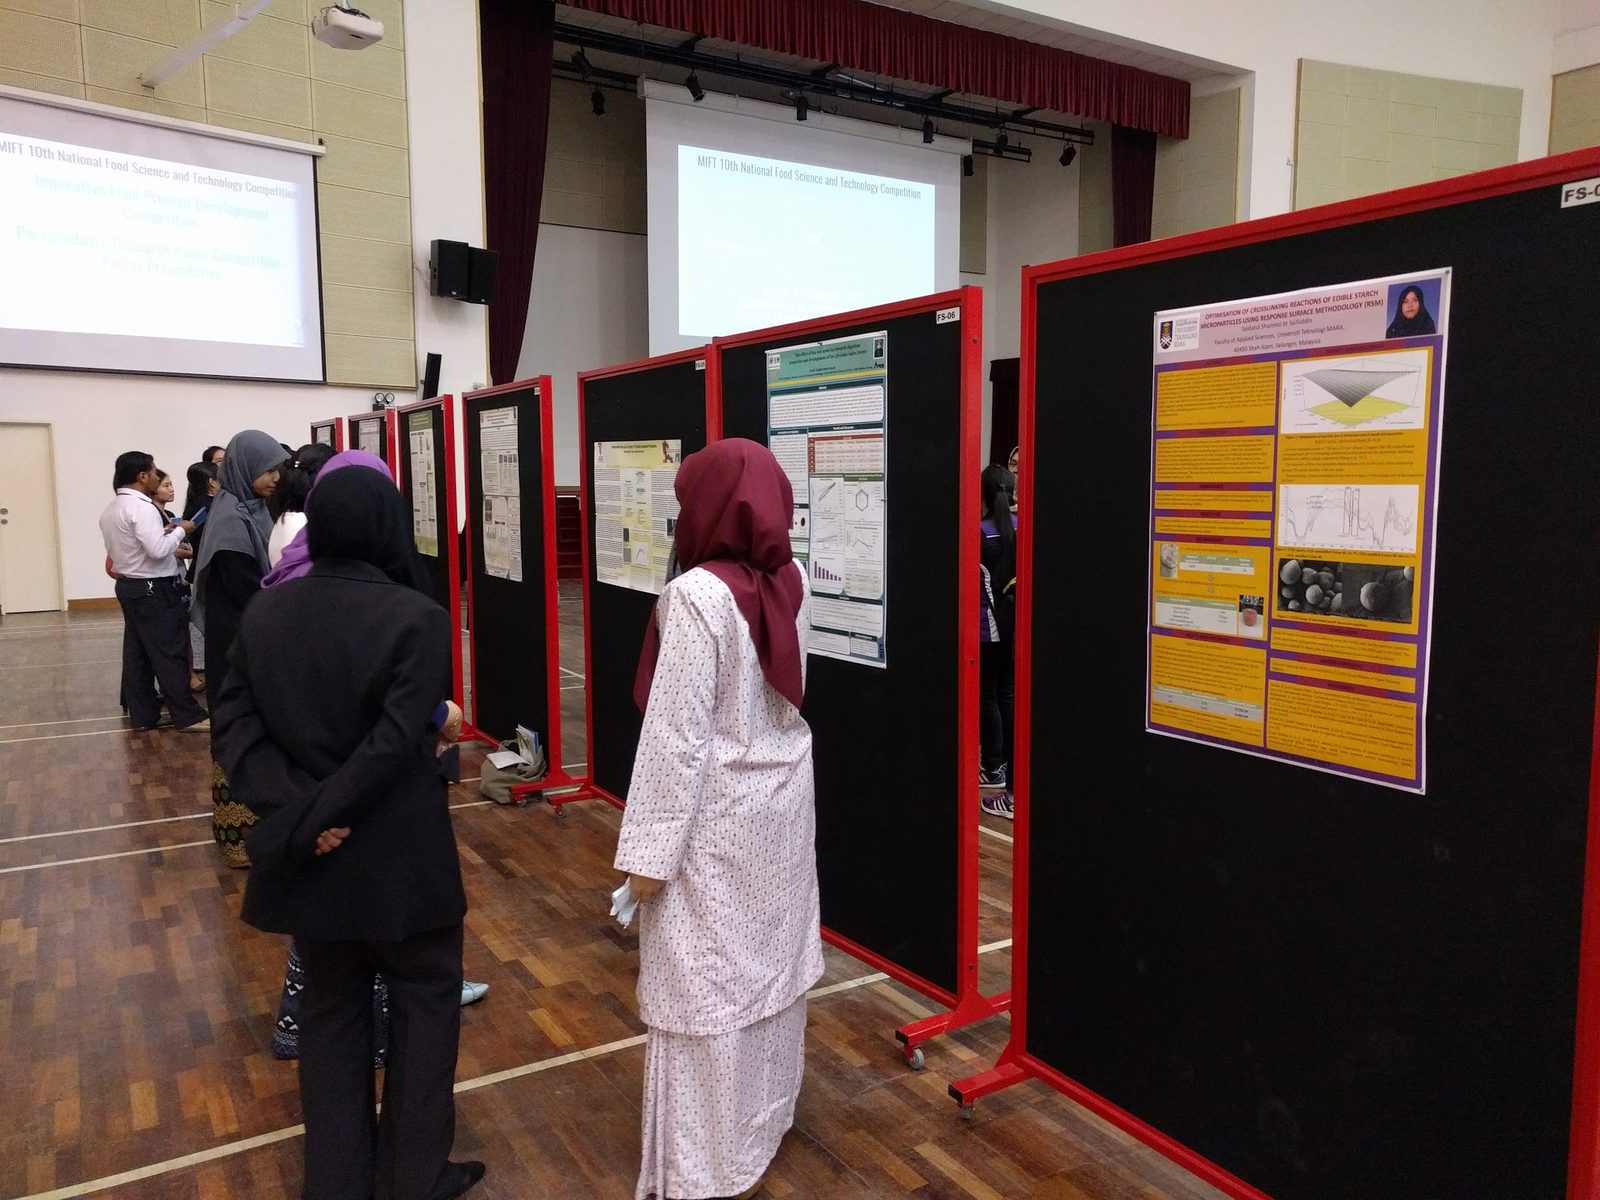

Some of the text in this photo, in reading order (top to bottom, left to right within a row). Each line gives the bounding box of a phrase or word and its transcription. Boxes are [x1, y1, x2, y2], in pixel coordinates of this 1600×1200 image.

[0, 140, 299, 201] MIFT 10th National Food Science and Technology Competition
[697, 154, 922, 199] MIFT 10th National Food Science and Technology Competition
[937, 311, 956, 321] FS-06
[1200, 318, 1241, 329] MICROPARTICLES
[1243, 315, 1259, 323] USING
[1260, 311, 1288, 321] RESPONSE
[1289, 308, 1313, 318] SURFACE
[1315, 302, 1363, 314] METHODOLOGY
[1364, 299, 1384, 309] (RSM)
[1205, 309, 1241, 320] OPTIMISATION
[1250, 303, 1289, 314] CROSSLINKING
[1290, 298, 1321, 308] REACTIONS
[1333, 293, 1353, 302] EDIBLE
[1354, 290, 1379, 299] STARCH
